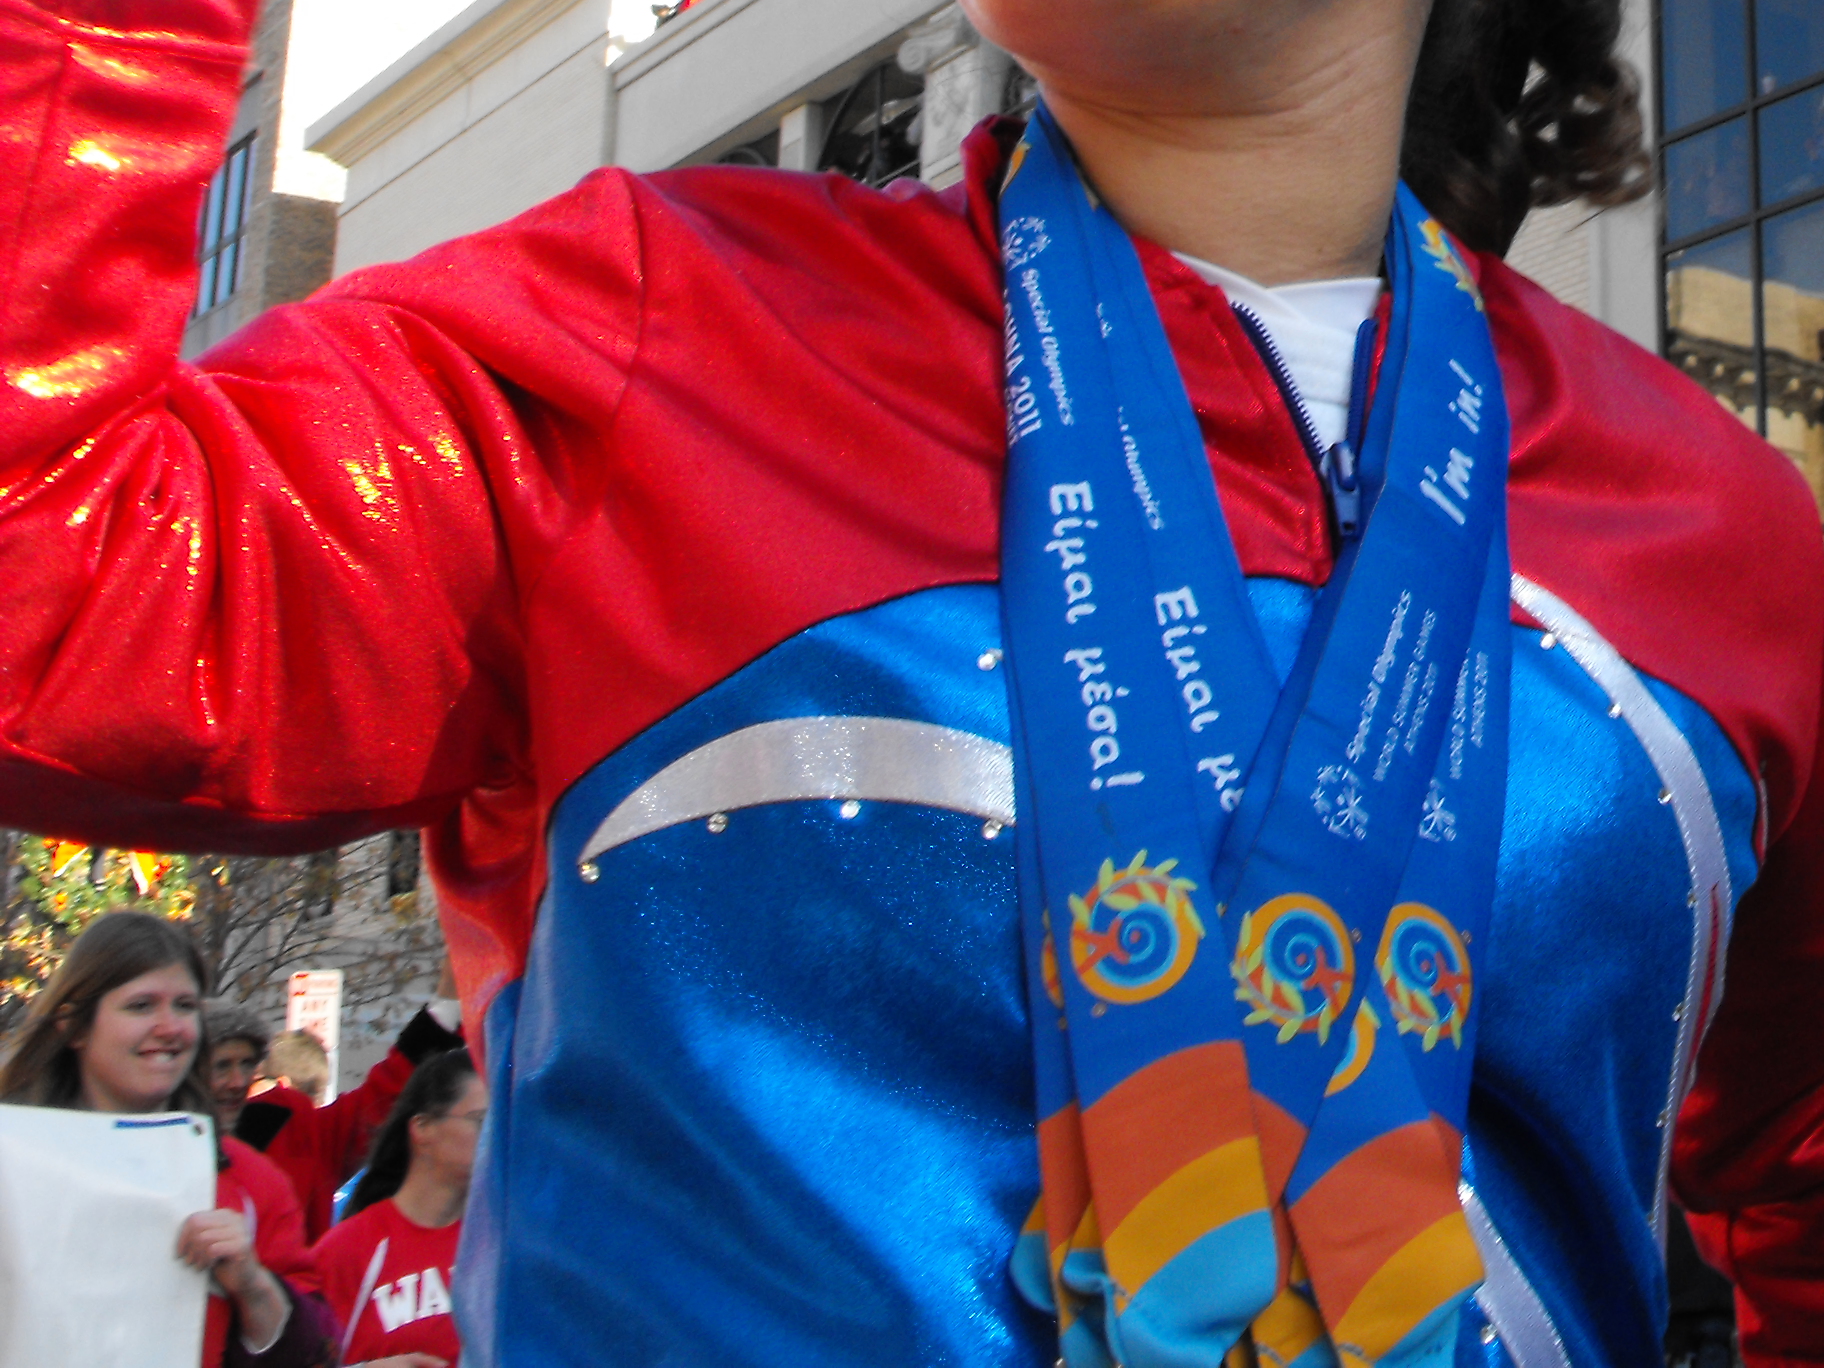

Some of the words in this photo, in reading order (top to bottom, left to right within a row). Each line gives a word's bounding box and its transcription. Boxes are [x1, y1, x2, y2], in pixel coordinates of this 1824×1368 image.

[1010, 376, 1043, 438] 2011
[1022, 267, 1053, 333] Special
[1041, 336, 1075, 426] Olympics
[1419, 447, 1474, 526] I'm
[1448, 358, 1483, 435] in!
[1345, 681, 1382, 764] Special
[1371, 589, 1412, 684] Olympics
[371, 1264, 456, 1334] WA
